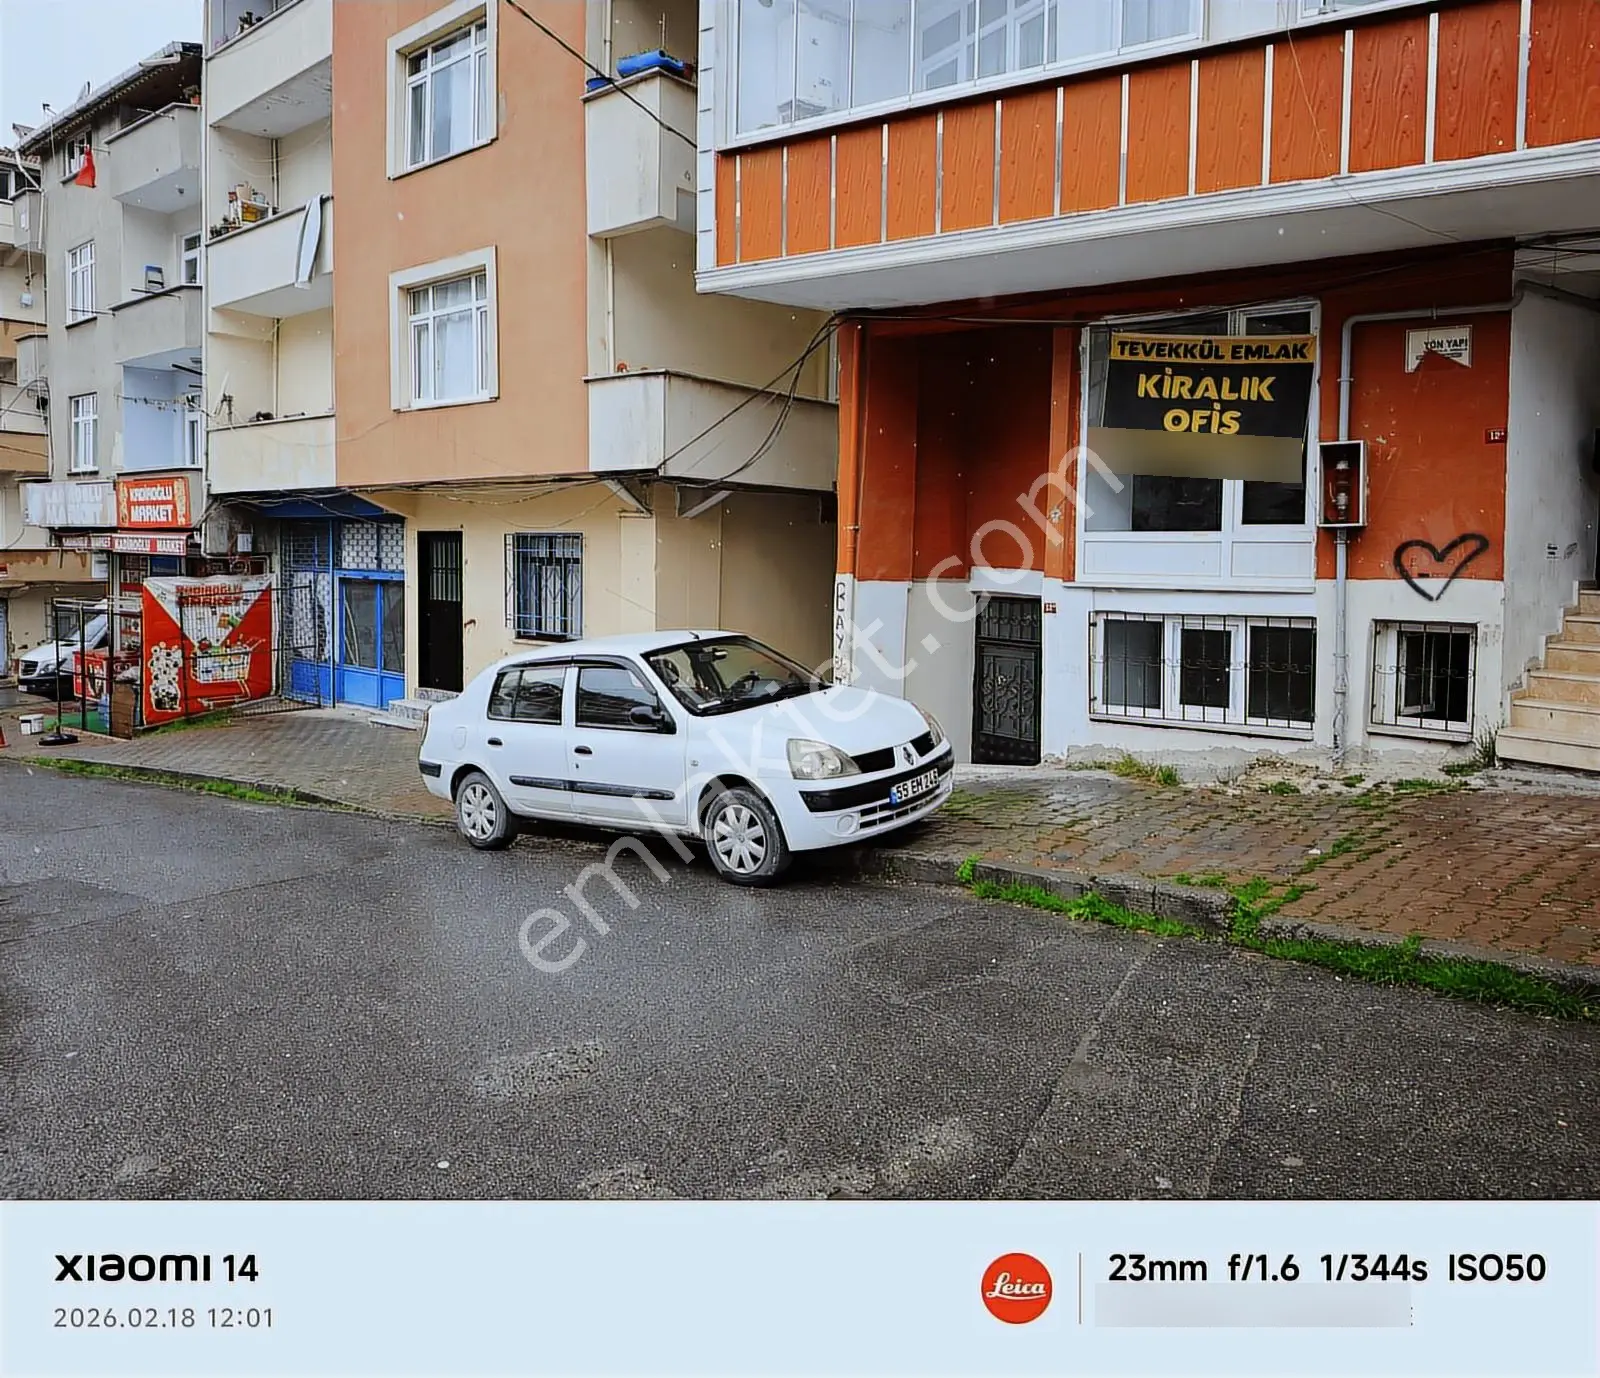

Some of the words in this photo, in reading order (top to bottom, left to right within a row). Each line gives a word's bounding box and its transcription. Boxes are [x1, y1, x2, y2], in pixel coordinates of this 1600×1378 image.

[1117, 339, 1225, 360] TEVEKKÜL
[1231, 343, 1309, 360] EMLAK
[1137, 367, 1276, 401] KİRALIK
[1163, 402, 1242, 434] OFİS
[131, 504, 173, 522] MARKET
[896, 783, 909, 799] 55
